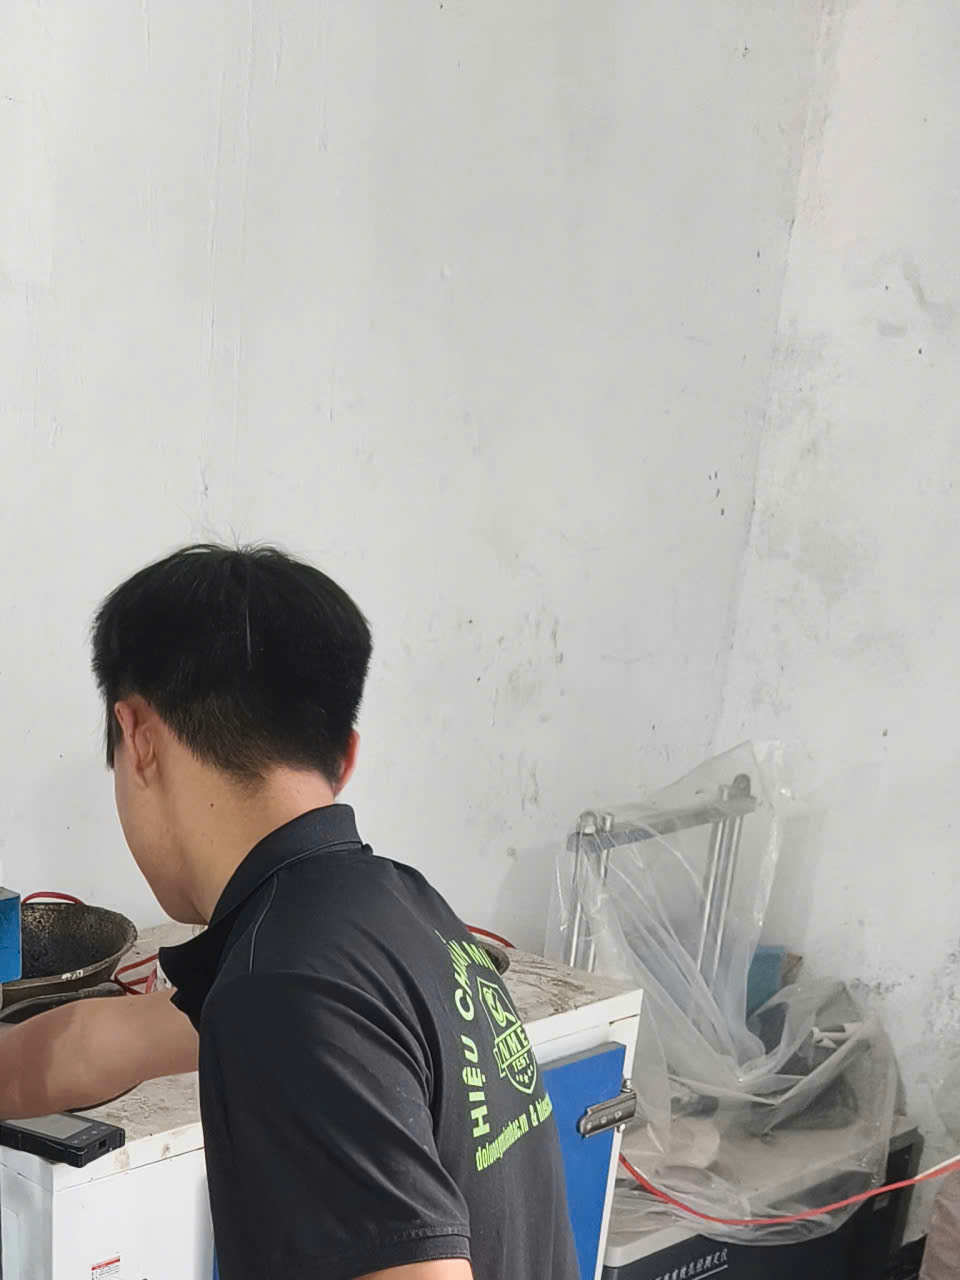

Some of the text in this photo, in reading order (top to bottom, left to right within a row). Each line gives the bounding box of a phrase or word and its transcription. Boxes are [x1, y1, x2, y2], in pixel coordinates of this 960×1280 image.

[499, 1027, 529, 1063] NME
[512, 1053, 530, 1072] TEST
[461, 1034, 490, 1138] HIỆU
